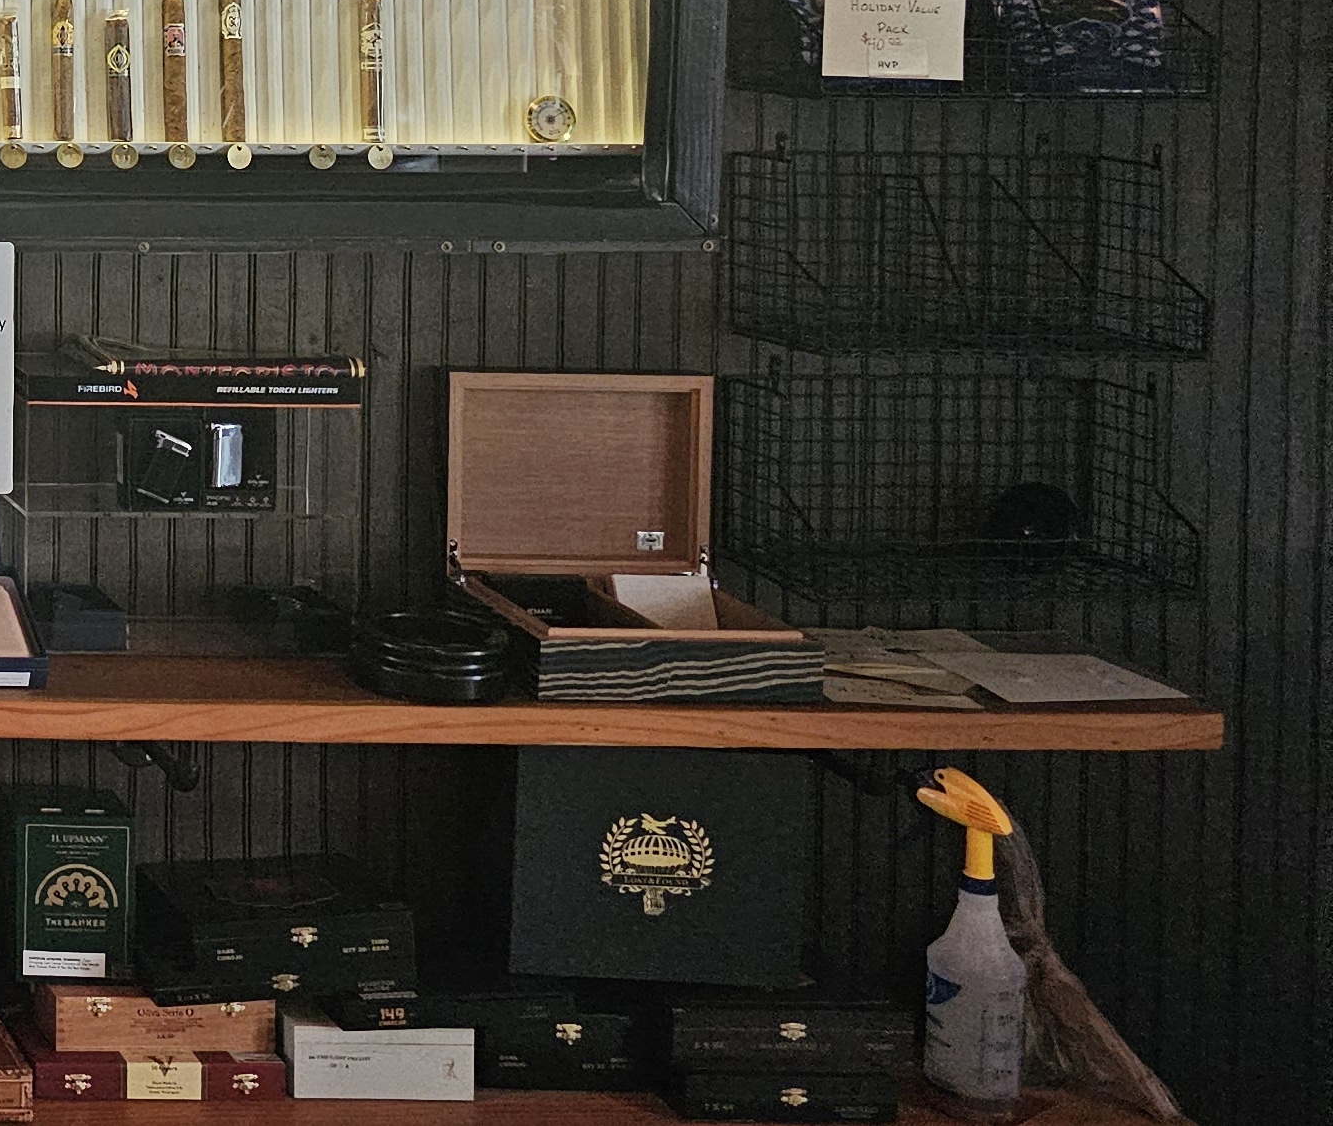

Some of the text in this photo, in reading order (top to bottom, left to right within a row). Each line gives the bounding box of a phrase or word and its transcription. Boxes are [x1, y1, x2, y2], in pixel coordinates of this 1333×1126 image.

[877, 22, 908, 35] PACK
[78, 385, 122, 393] FIREBIRD
[380, 1008, 405, 1020] 149
